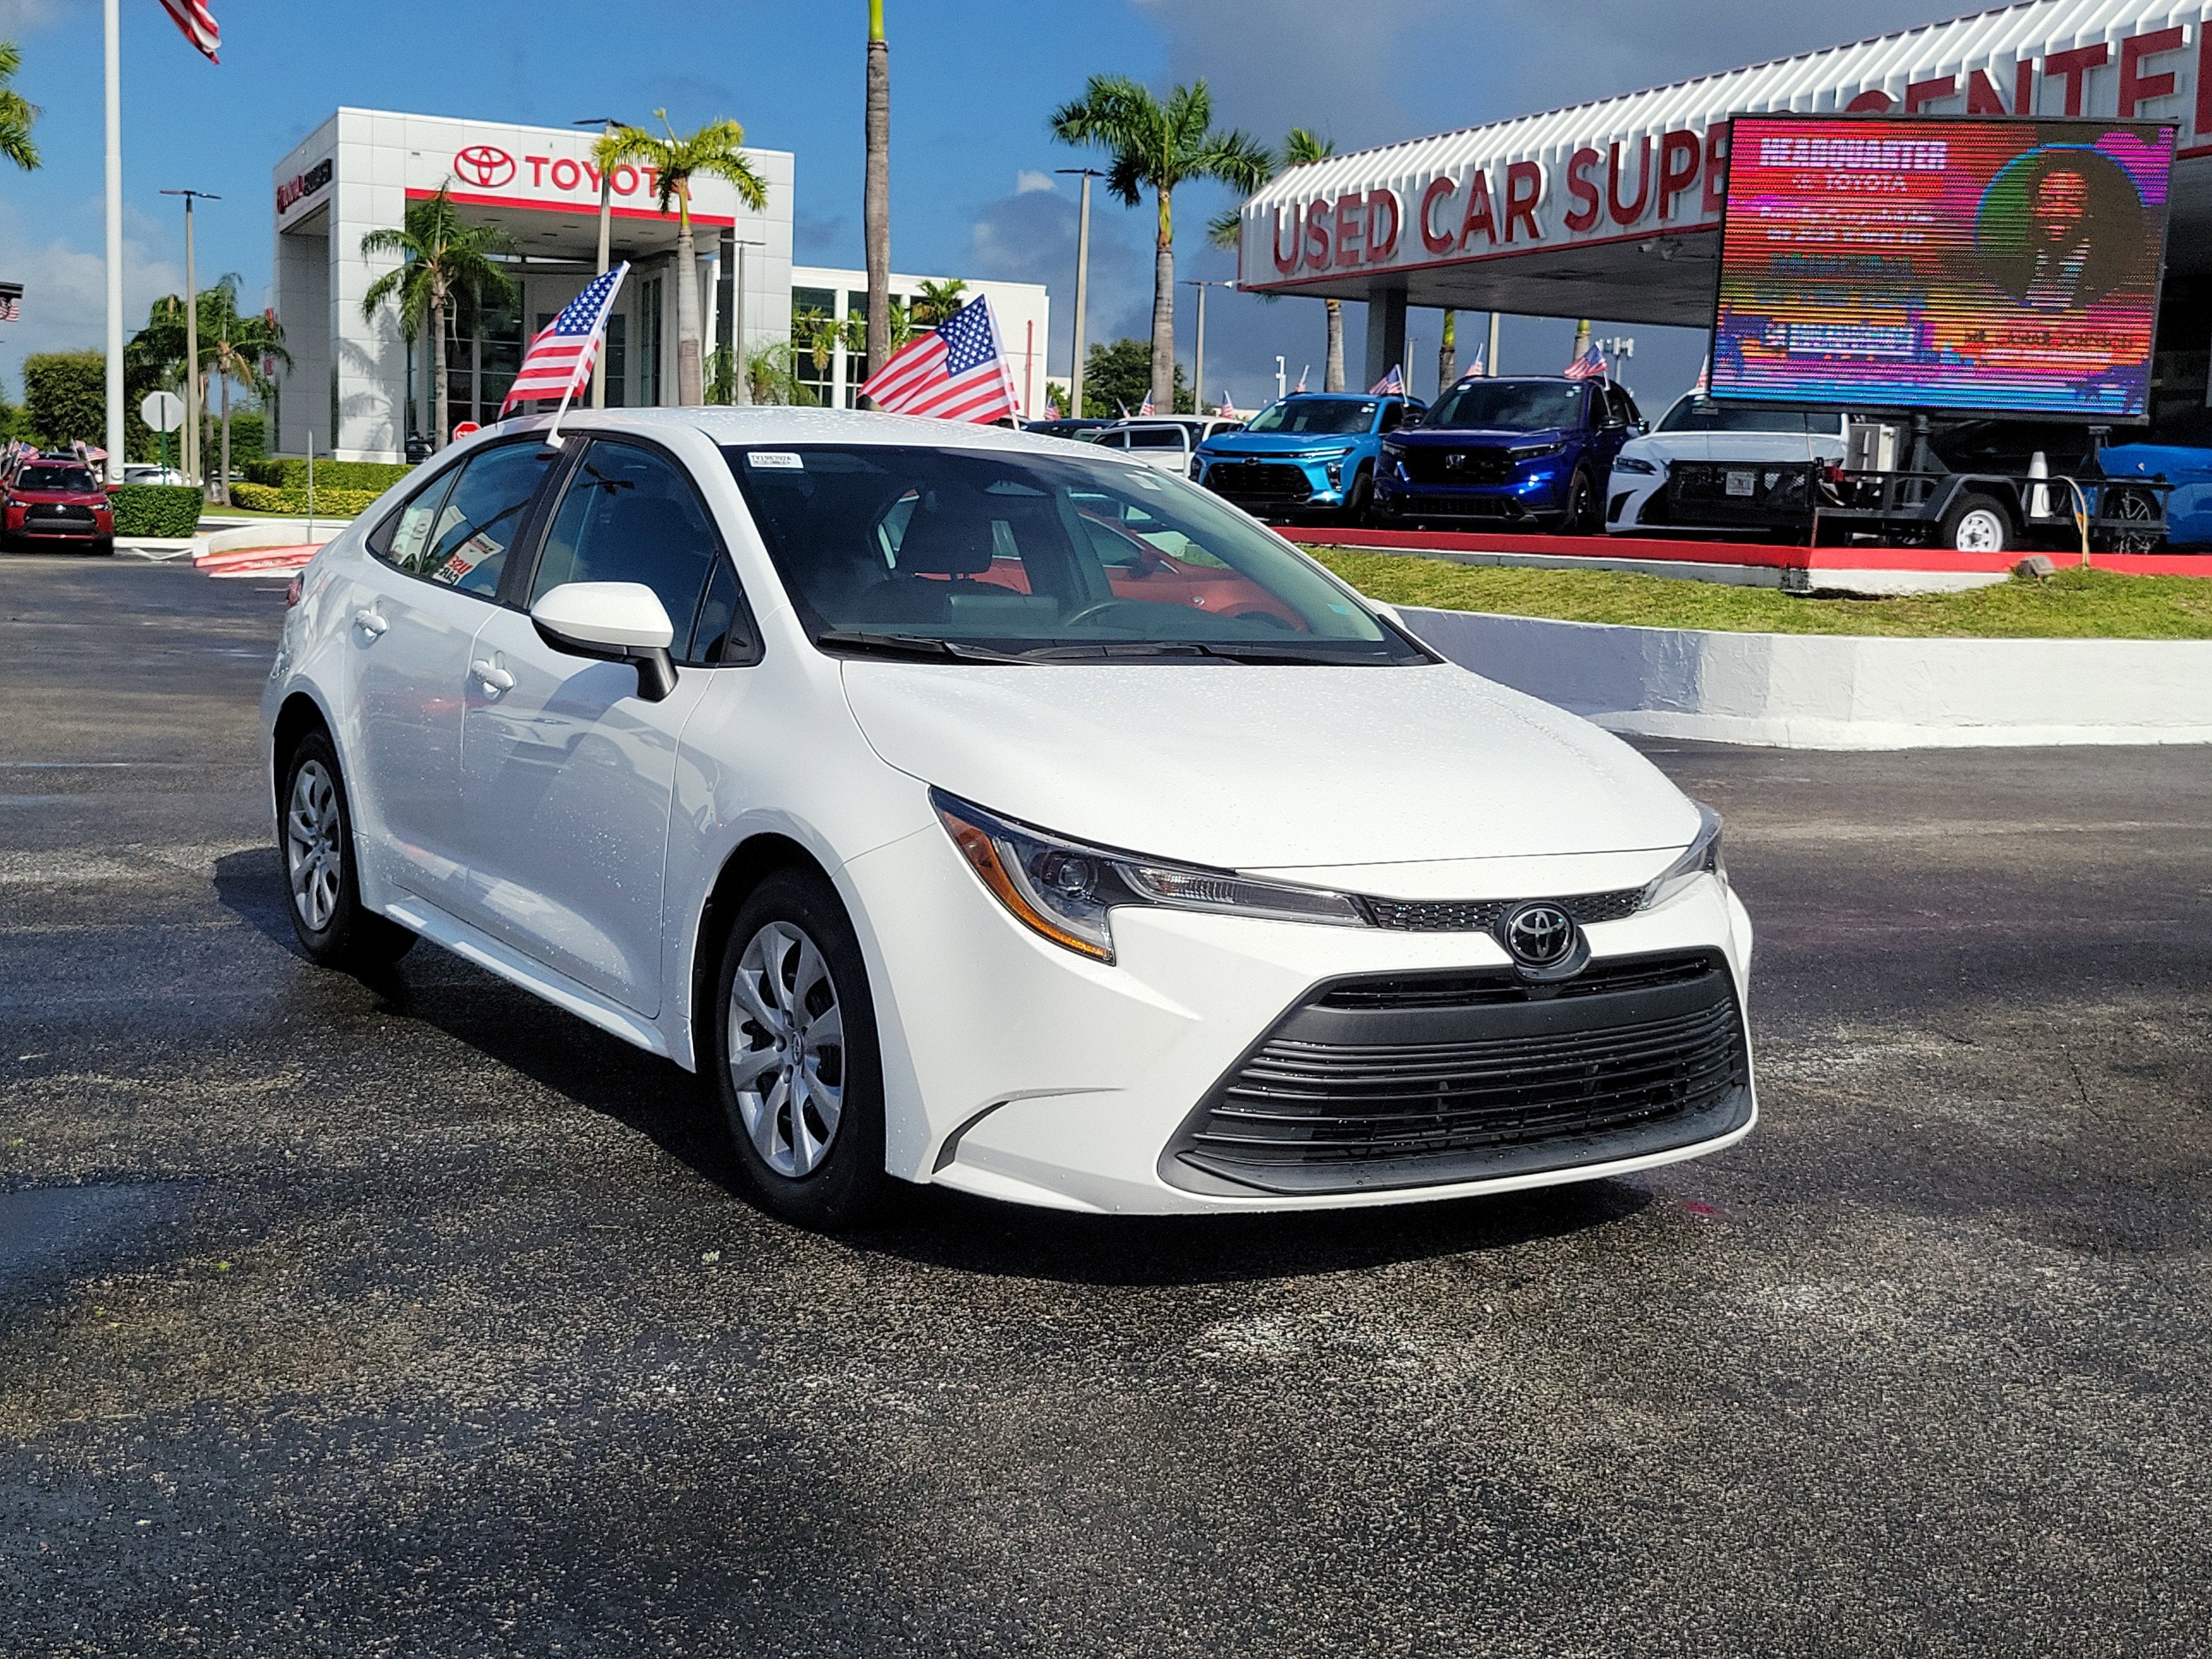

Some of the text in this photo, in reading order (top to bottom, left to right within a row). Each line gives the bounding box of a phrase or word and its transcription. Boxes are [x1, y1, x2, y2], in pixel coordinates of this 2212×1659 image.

[1759, 137, 1948, 170] HEADQUARTER
[1274, 189, 1398, 274] USED
[1420, 161, 1541, 254] CAR
[1563, 121, 1730, 232] SUPE
[1825, 173, 1908, 193] TOYOTA
